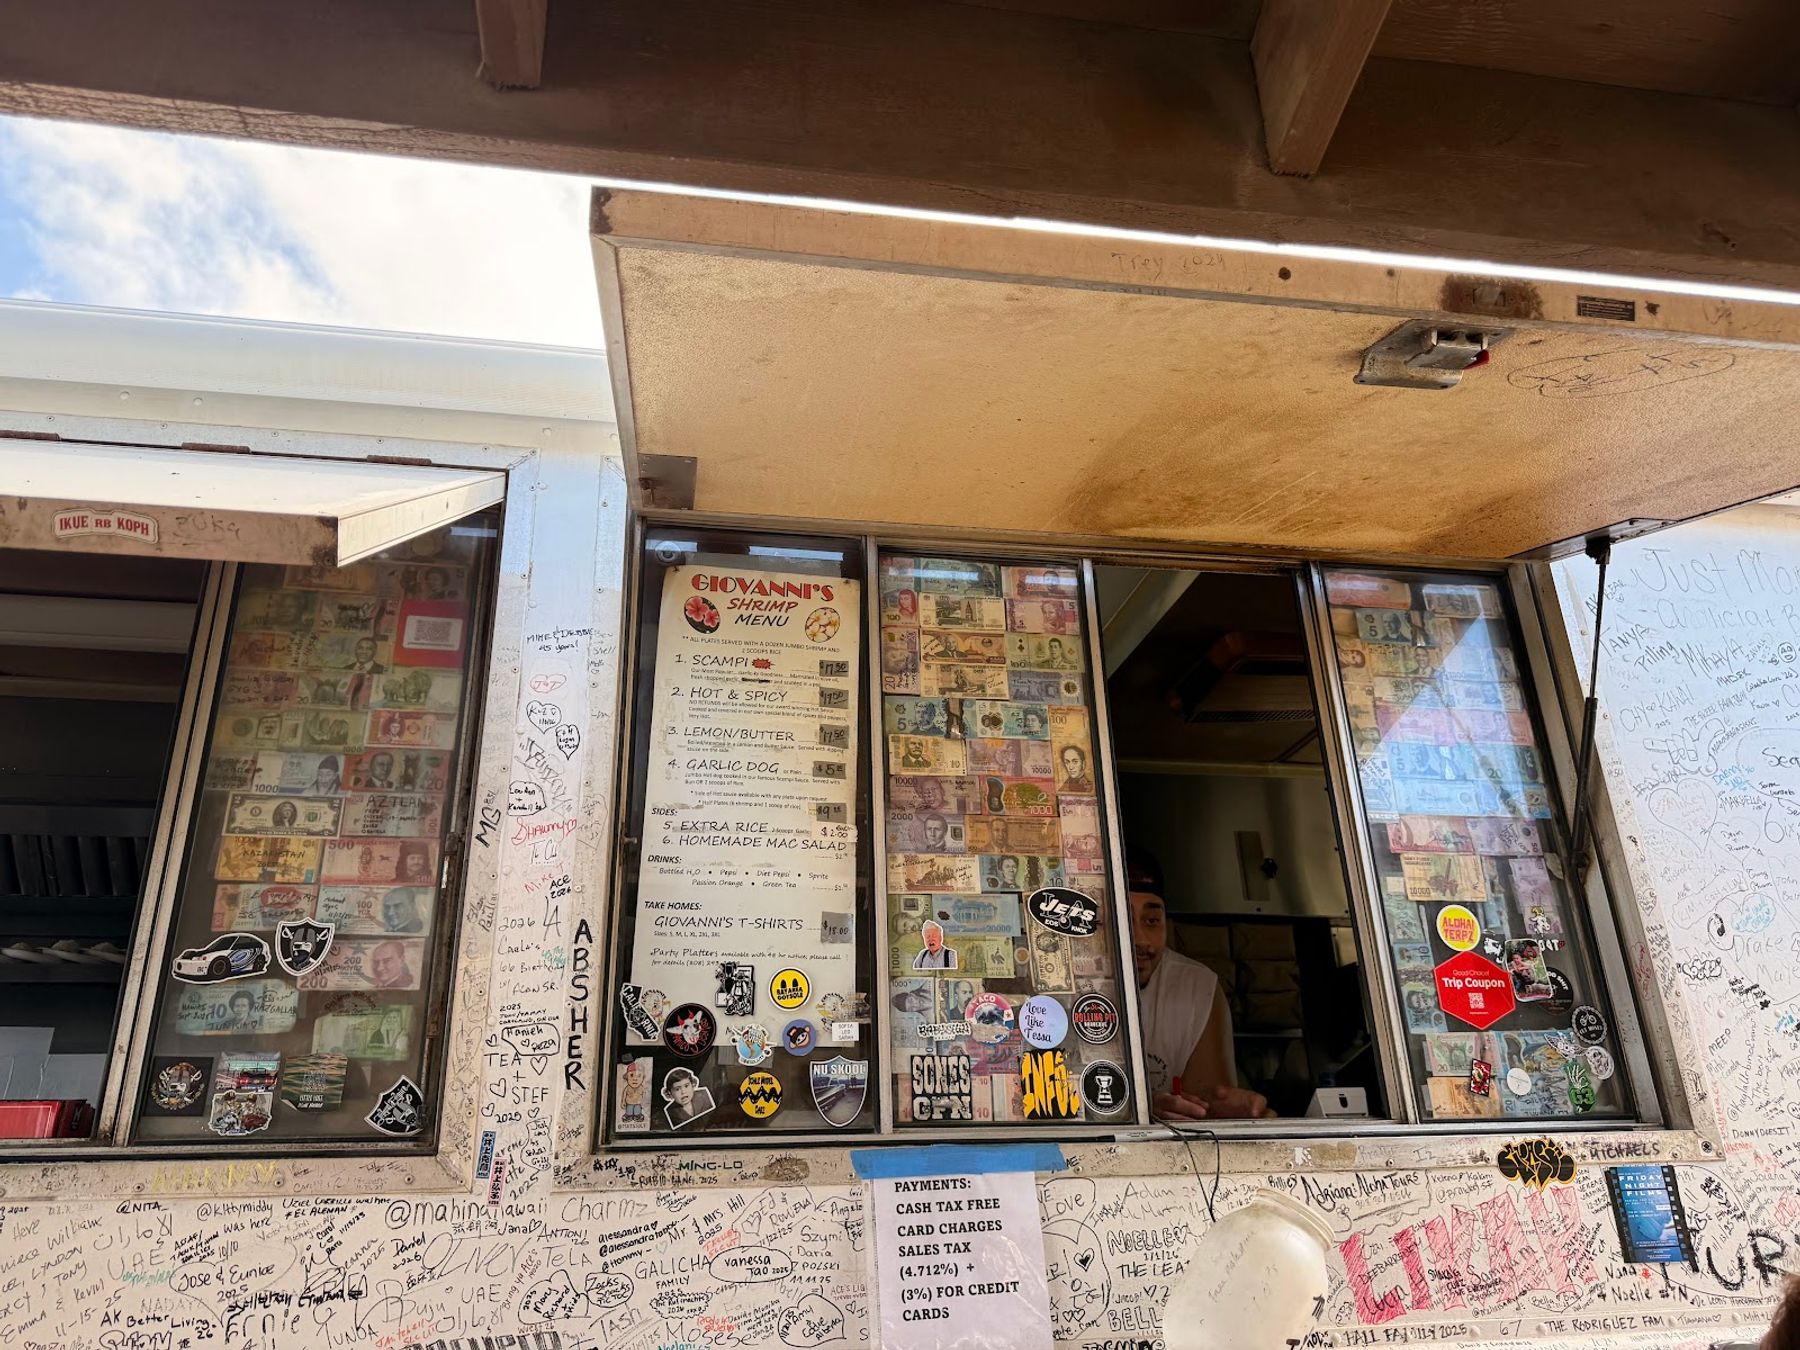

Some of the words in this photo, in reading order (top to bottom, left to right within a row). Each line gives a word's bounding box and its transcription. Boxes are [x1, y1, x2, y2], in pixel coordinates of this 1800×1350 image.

[59, 515, 89, 531] IKUE
[95, 518, 112, 529] RB
[117, 517, 149, 535] KOPH
[691, 573, 834, 602] GIOVANNI'S
[727, 597, 798, 613] SHRIMP
[734, 613, 790, 627] MENU
[675, 653, 687, 664] 1.
[692, 654, 748, 668] SCAMPI
[670, 687, 684, 697] 2.
[690, 686, 723, 699] HOT
[728, 690, 740, 700] &
[744, 690, 788, 702] SPICY
[668, 725, 679, 735] 3.
[683, 725, 795, 743] LEMON/BUTTER
[667, 758, 681, 769] 4.
[686, 759, 742, 773] GARLIC
[746, 761, 779, 774] DOG
[254, 783, 279, 793] 1000
[651, 807, 678, 817] SIDES:
[891, 812, 914, 822] 2000
[680, 821, 731, 833] EXTRA
[735, 822, 769, 834] RICE
[328, 839, 355, 851] 500
[662, 836, 673, 845] 6.
[679, 834, 762, 849] HOMEMADE
[766, 838, 798, 849] MAC
[800, 839, 847, 851] SALAD
[647, 854, 682, 864] DRINKS:
[658, 867, 684, 876] Bottled
[719, 869, 737, 878] Pepsi
[756, 869, 770, 878] Diet
[773, 870, 790, 879] Pepsi
[808, 872, 829, 881] Sprite
[692, 878, 717, 887] Passion
[718, 878, 743, 889] Orange
[762, 880, 784, 889] Green
[786, 881, 797, 889] Tea
[644, 901, 666, 910] TAKE
[667, 901, 702, 911] HOMES:
[1039, 898, 1096, 921] JETS
[654, 915, 734, 929] GIOVANNI'S
[738, 917, 804, 931] T-SHIRTS
[301, 977, 328, 989] 200
[1441, 977, 1463, 989] Trip
[1464, 978, 1506, 990] Coupon
[564, 918, 594, 1091] ABSHER
[1025, 1001, 1047, 1015] Love
[1024, 1014, 1045, 1028] Like
[1023, 1027, 1052, 1043] Tessa
[813, 1064, 828, 1075] NU
[830, 1064, 866, 1075] SKOOL
[894, 1178, 971, 1193] PAYMENTS:
[1618, 1174, 1662, 1182] FRIDAY
[1624, 1182, 1660, 1190] NIGHT
[896, 1201, 932, 1215] CASH
[936, 1200, 963, 1213] TAX
[967, 1198, 1001, 1210] FREE
[897, 1224, 934, 1237] CARD
[939, 1220, 1003, 1235] CHARGES
[899, 1243, 940, 1257] SALES
[943, 1242, 972, 1254] TAX
[900, 1262, 959, 1281] (4.712%)
[966, 1263, 975, 1272] +
[901, 1286, 933, 1303] (3%)
[937, 1285, 964, 1299] FOR
[968, 1281, 1020, 1296] CREDIT
[902, 1307, 950, 1322] CARDS
[1545, 1320, 1568, 1333] THE
[1572, 1316, 1637, 1332] RODRIGUEZ
